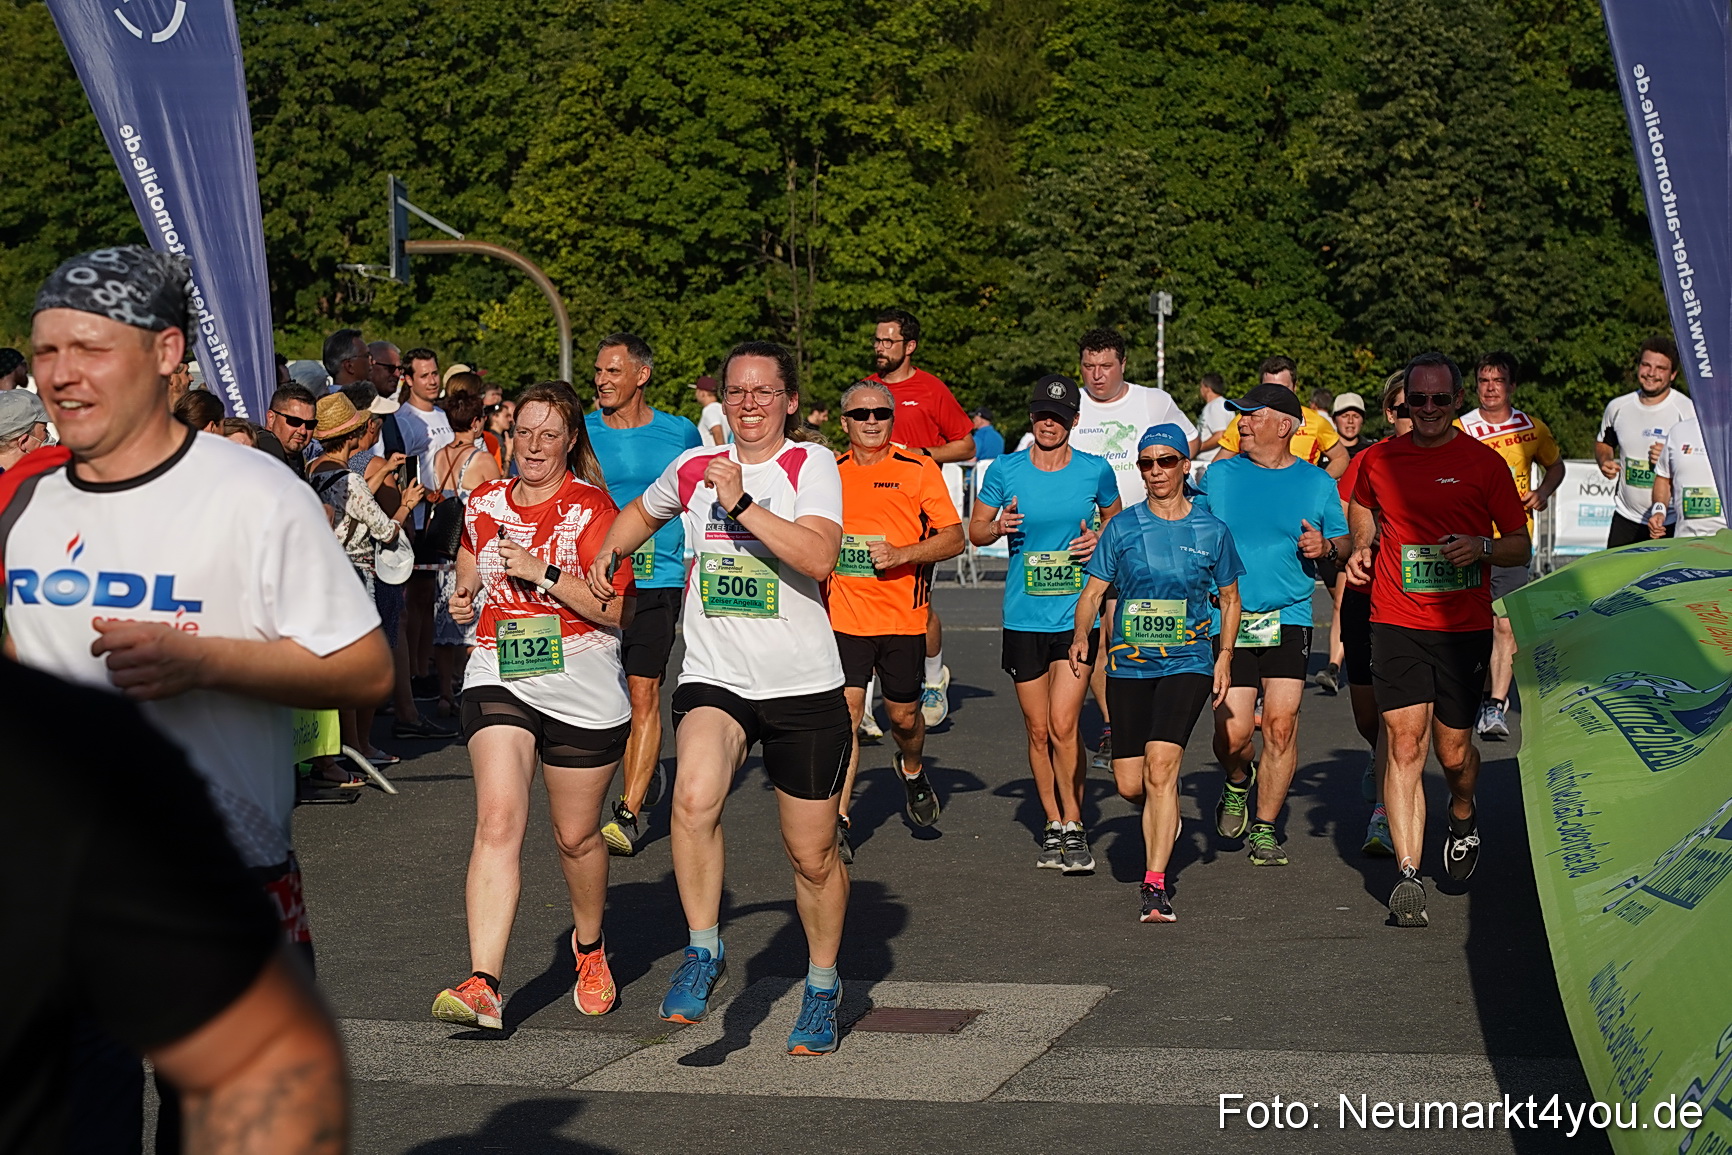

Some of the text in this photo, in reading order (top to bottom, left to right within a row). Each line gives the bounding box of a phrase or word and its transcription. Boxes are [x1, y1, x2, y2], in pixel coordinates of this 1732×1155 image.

[1504, 432, 1538, 447] BÖGL
[1631, 468, 1651, 479] 526
[1580, 483, 1614, 496] NOW
[1691, 496, 1712, 508] 173
[1188, 547, 1210, 556] PLAST
[1033, 565, 1074, 581] 1342
[1412, 561, 1456, 577] 1763
[717, 575, 758, 598] 506
[710, 596, 762, 607] Zeiser Angelika
[766, 582, 775, 610] 2022
[1132, 614, 1176, 632] 1899
[1176, 618, 1184, 640] 2022
[501, 637, 550, 659] 1132
[550, 638, 560, 666] 2022
